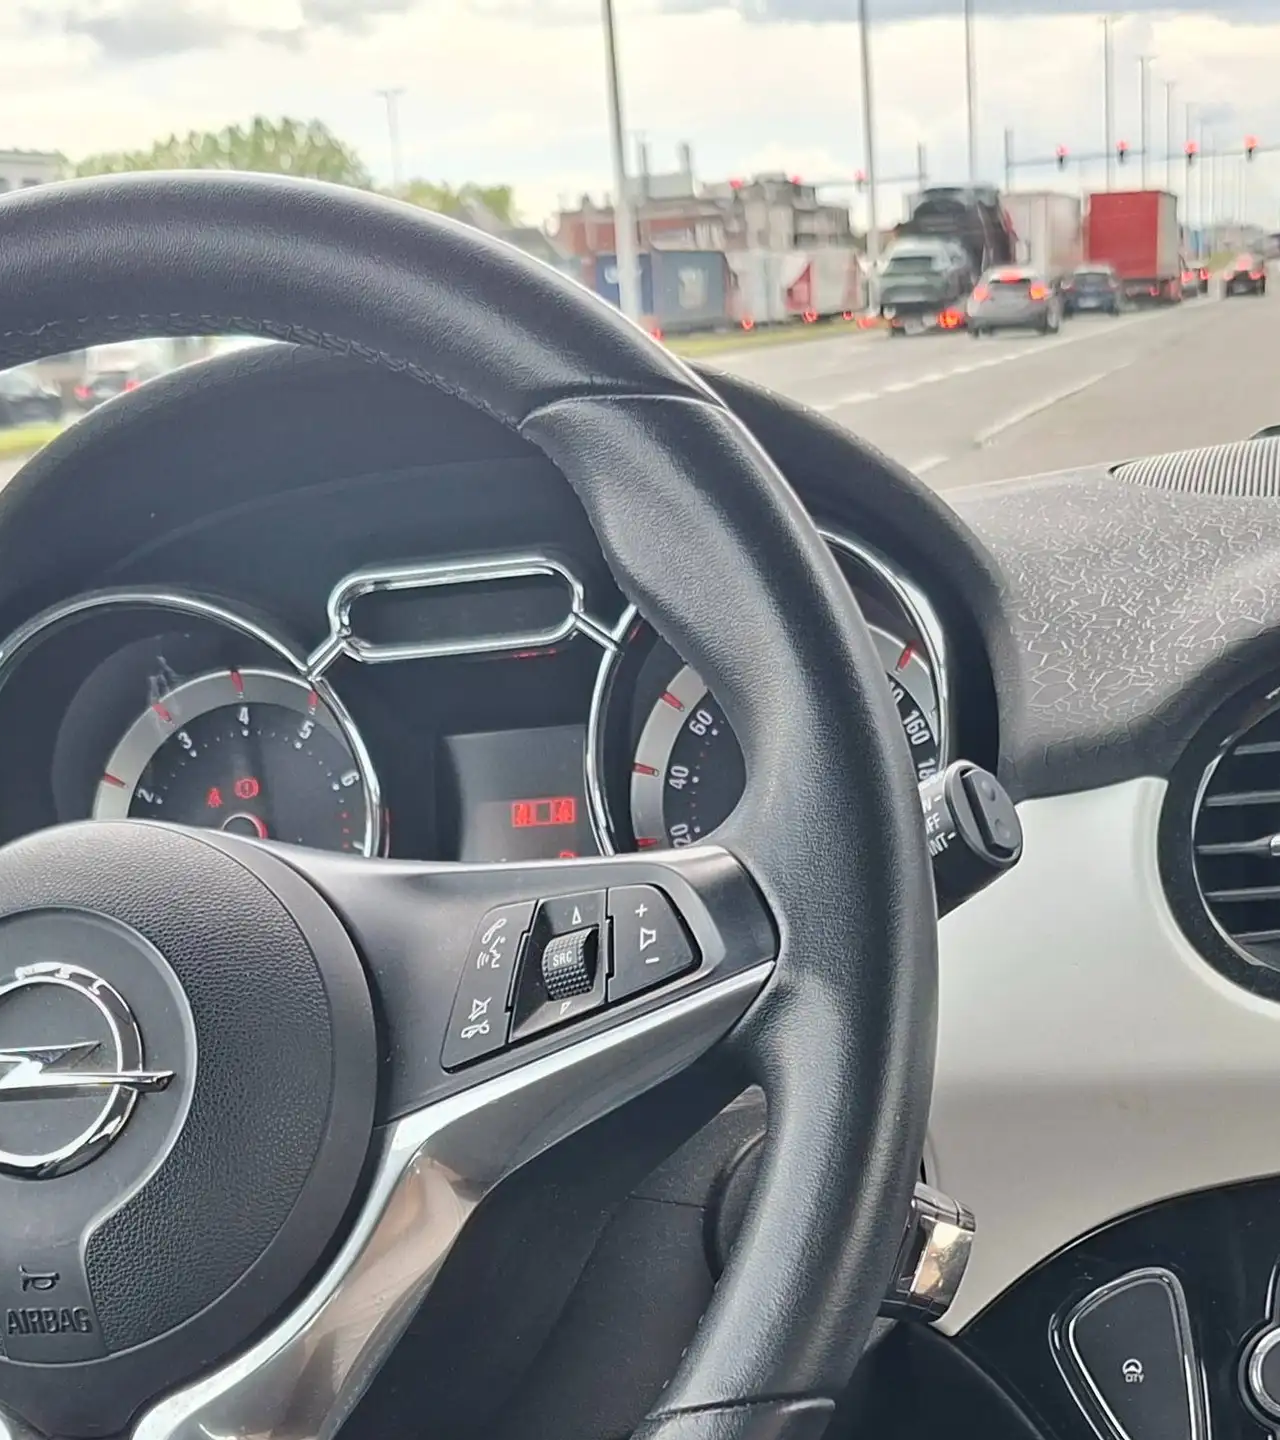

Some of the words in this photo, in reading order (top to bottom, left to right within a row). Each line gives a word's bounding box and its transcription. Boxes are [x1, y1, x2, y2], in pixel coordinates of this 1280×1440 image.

[238, 707, 249, 725] 4
[689, 709, 713, 736] 60
[903, 710, 930, 745] 160
[178, 731, 193, 749] 3
[298, 721, 314, 739] 5
[340, 770, 359, 787] 6
[669, 765, 689, 790] 40
[918, 758, 937, 781] 18
[136, 788, 154, 802] 2
[925, 812, 941, 835] FF
[670, 823, 692, 848] 20
[553, 950, 572, 967] SRC
[6, 1306, 92, 1335] AIRBAG
